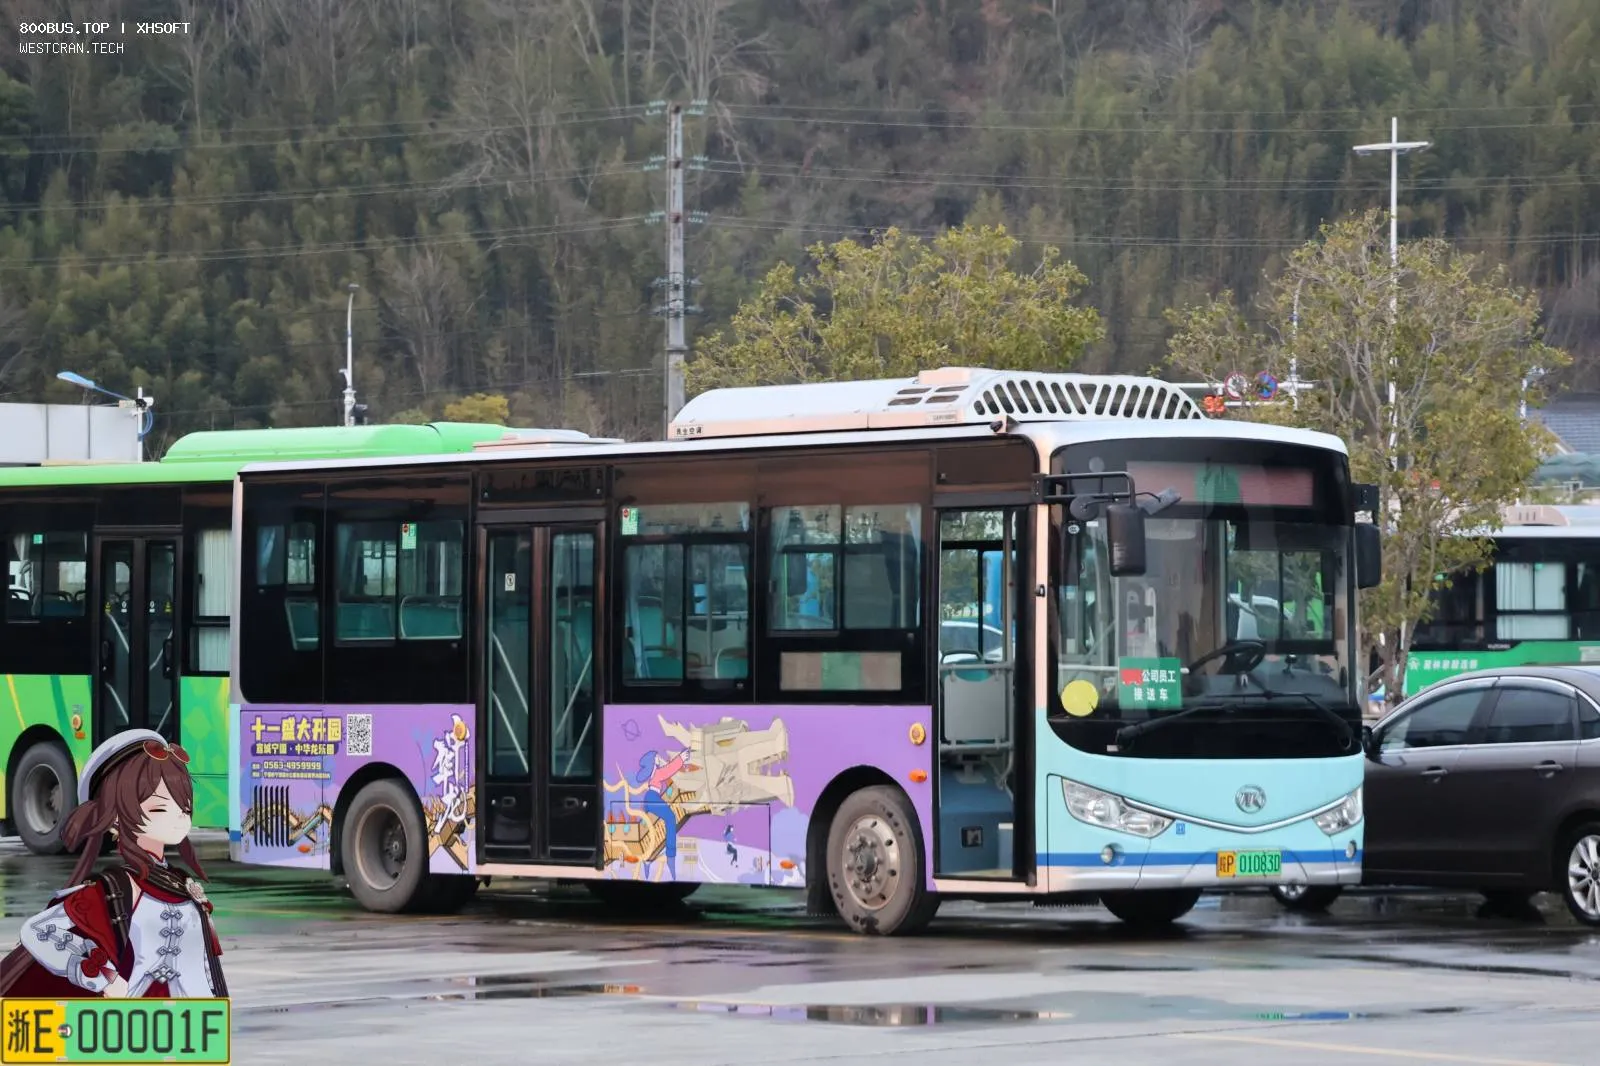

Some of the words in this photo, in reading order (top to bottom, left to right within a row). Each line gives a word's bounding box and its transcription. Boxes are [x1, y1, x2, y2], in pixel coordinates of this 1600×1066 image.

[1122, 669, 1176, 684] 公司员工
[251, 716, 342, 741] 十一盛大开园
[263, 761, 322, 770] 0563-4959999
